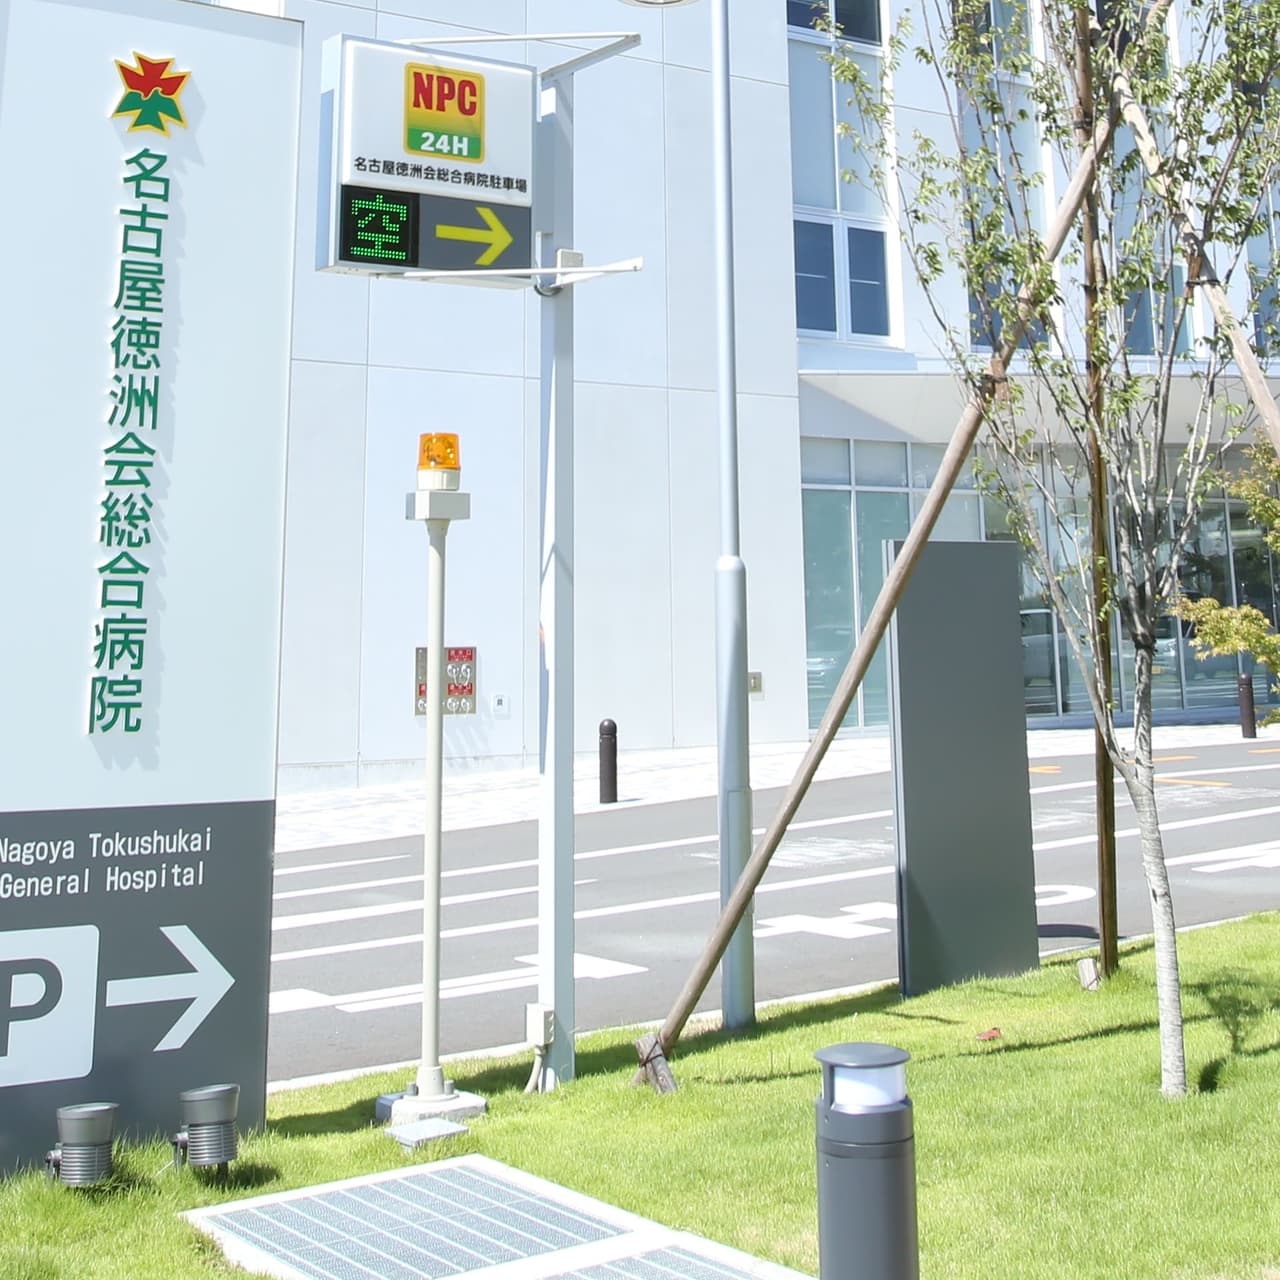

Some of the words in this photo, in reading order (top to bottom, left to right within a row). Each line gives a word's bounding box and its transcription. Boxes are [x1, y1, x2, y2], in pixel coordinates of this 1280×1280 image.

[412, 72, 478, 117] NPC
[420, 131, 469, 157] 24H
[353, 156, 528, 194] 名古屋徳洲会総合病院駐車場
[350, 194, 408, 261] 空
[87, 147, 171, 736] 名古屋徳洲会総合病院
[89, 826, 212, 859] Tokushukai
[105, 861, 205, 894] Hospital
